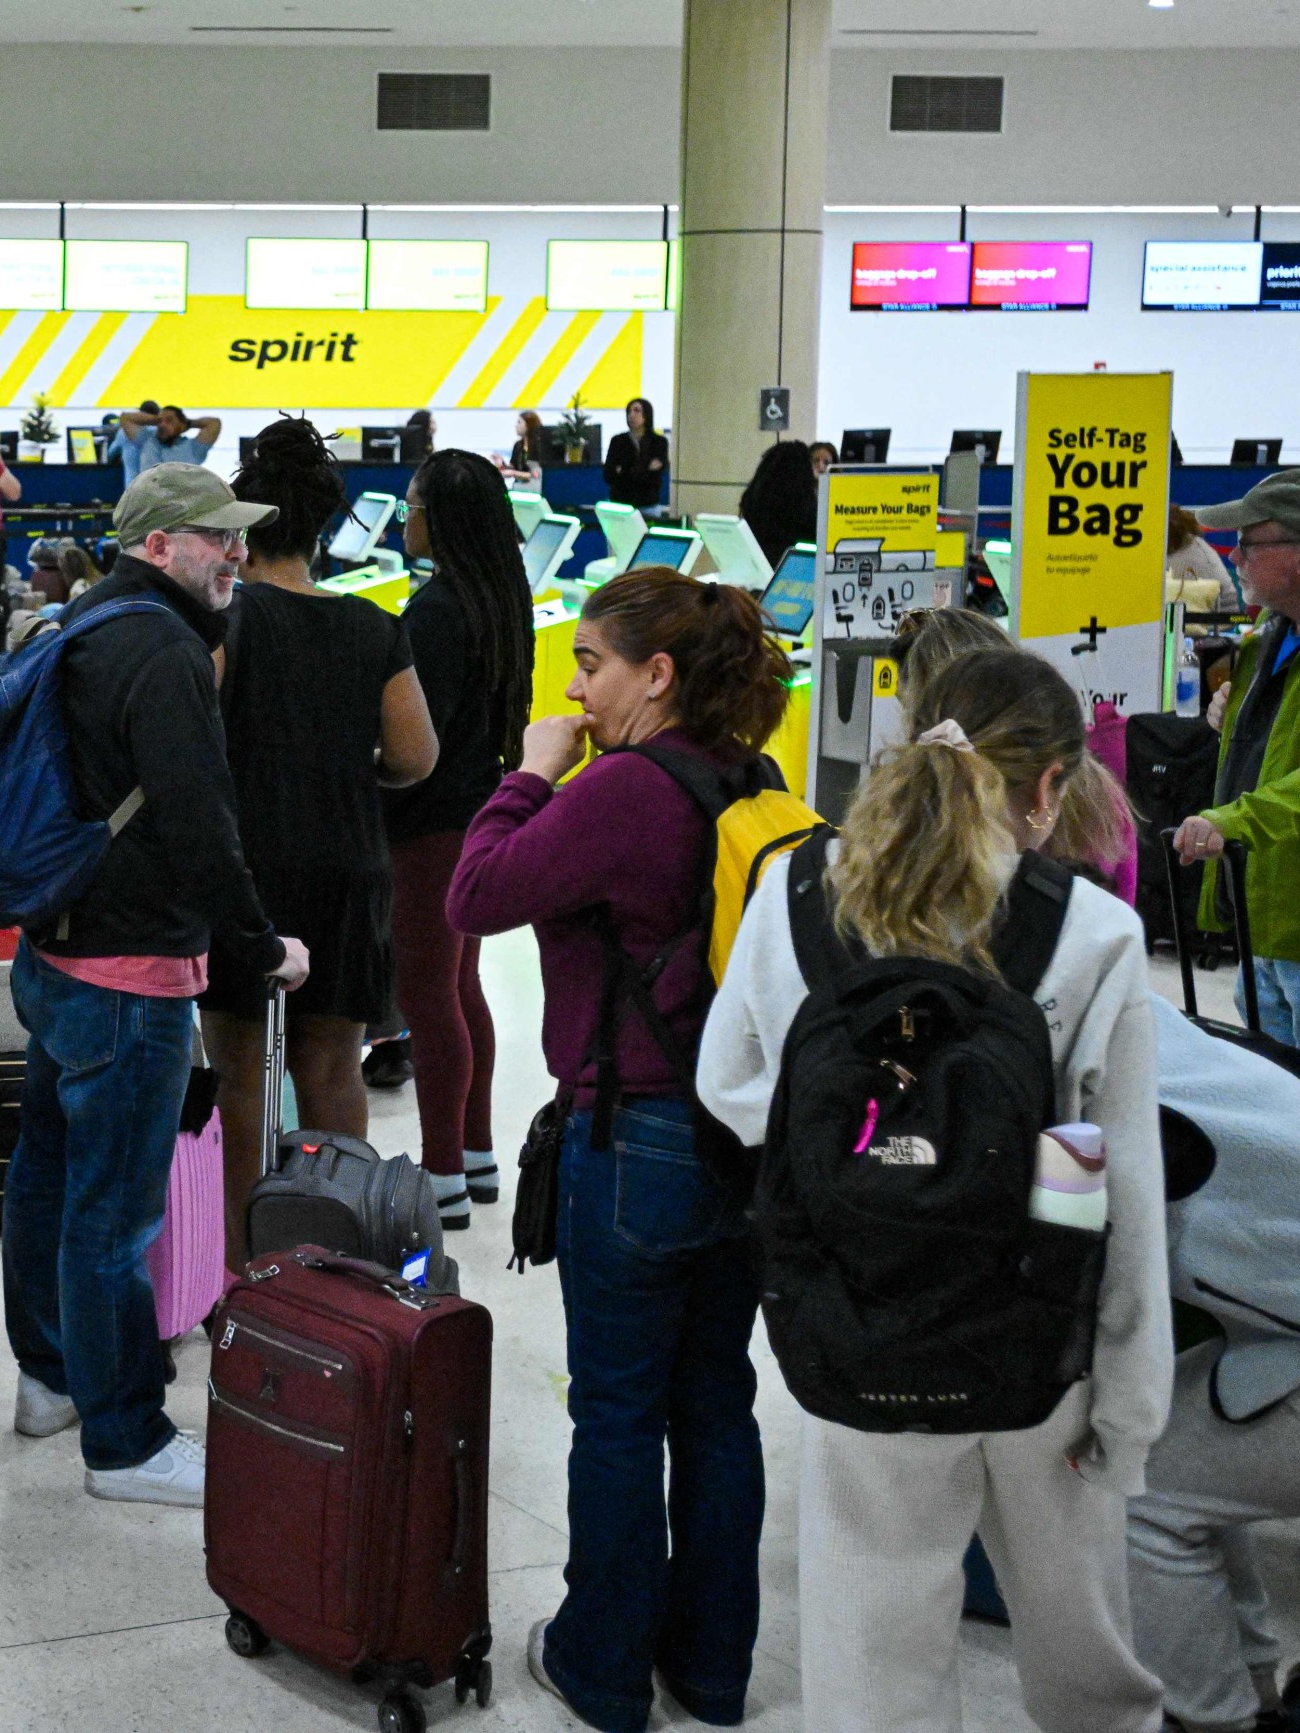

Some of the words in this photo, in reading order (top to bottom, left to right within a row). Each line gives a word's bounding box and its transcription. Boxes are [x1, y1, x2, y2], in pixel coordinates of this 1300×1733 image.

[228, 332, 359, 369] spirit
[1048, 428, 1147, 453] Self-Tag
[1047, 454, 1147, 488] Your
[834, 504, 878, 515] Measure
[881, 504, 903, 514] Your
[907, 504, 931, 516] Bags
[1047, 495, 1143, 547] Bag
[886, 1136, 911, 1146] THE
[868, 1146, 912, 1156] NORTH
[881, 1156, 913, 1165] FACE
